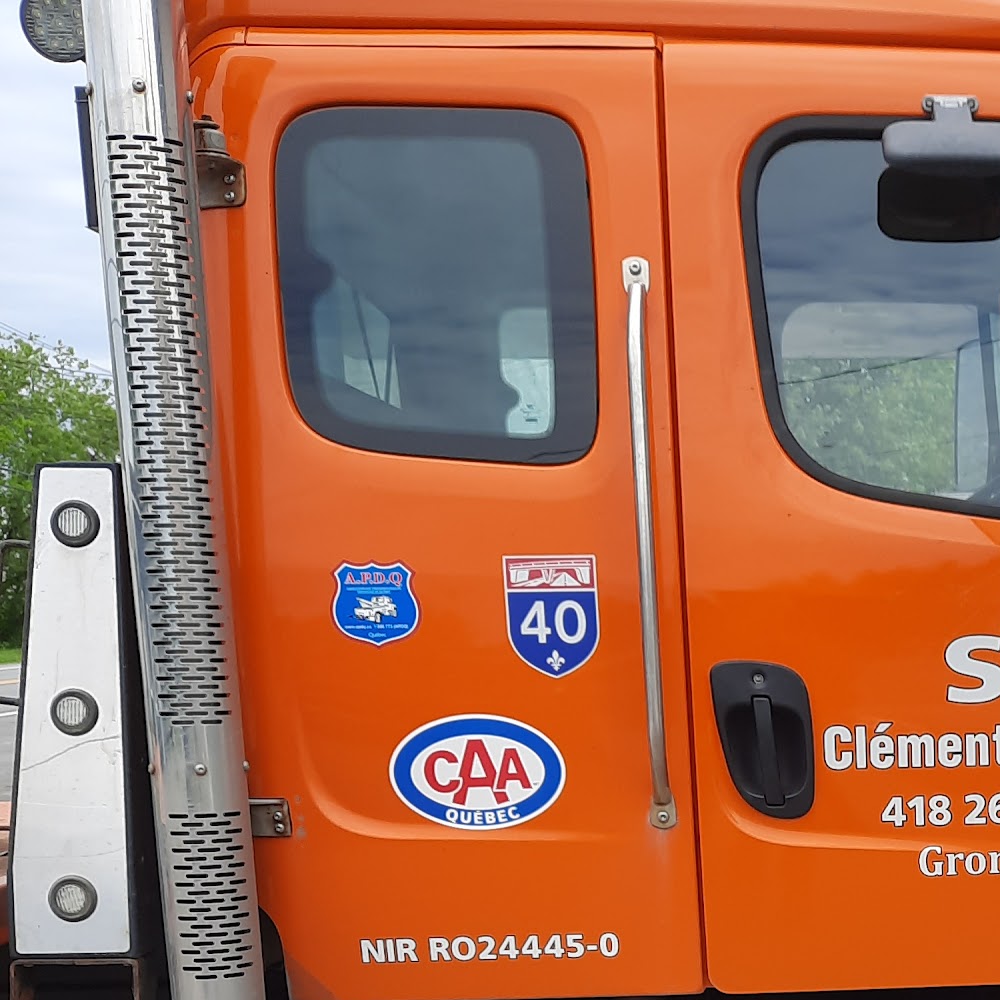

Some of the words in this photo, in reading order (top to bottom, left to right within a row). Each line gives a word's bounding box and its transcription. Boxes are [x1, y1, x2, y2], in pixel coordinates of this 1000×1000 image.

[520, 599, 587, 644] 40
[423, 738, 533, 806] CAA
[445, 805, 521, 825] QUÉBEC
[881, 795, 953, 827] 418
[360, 937, 419, 964] NIR
